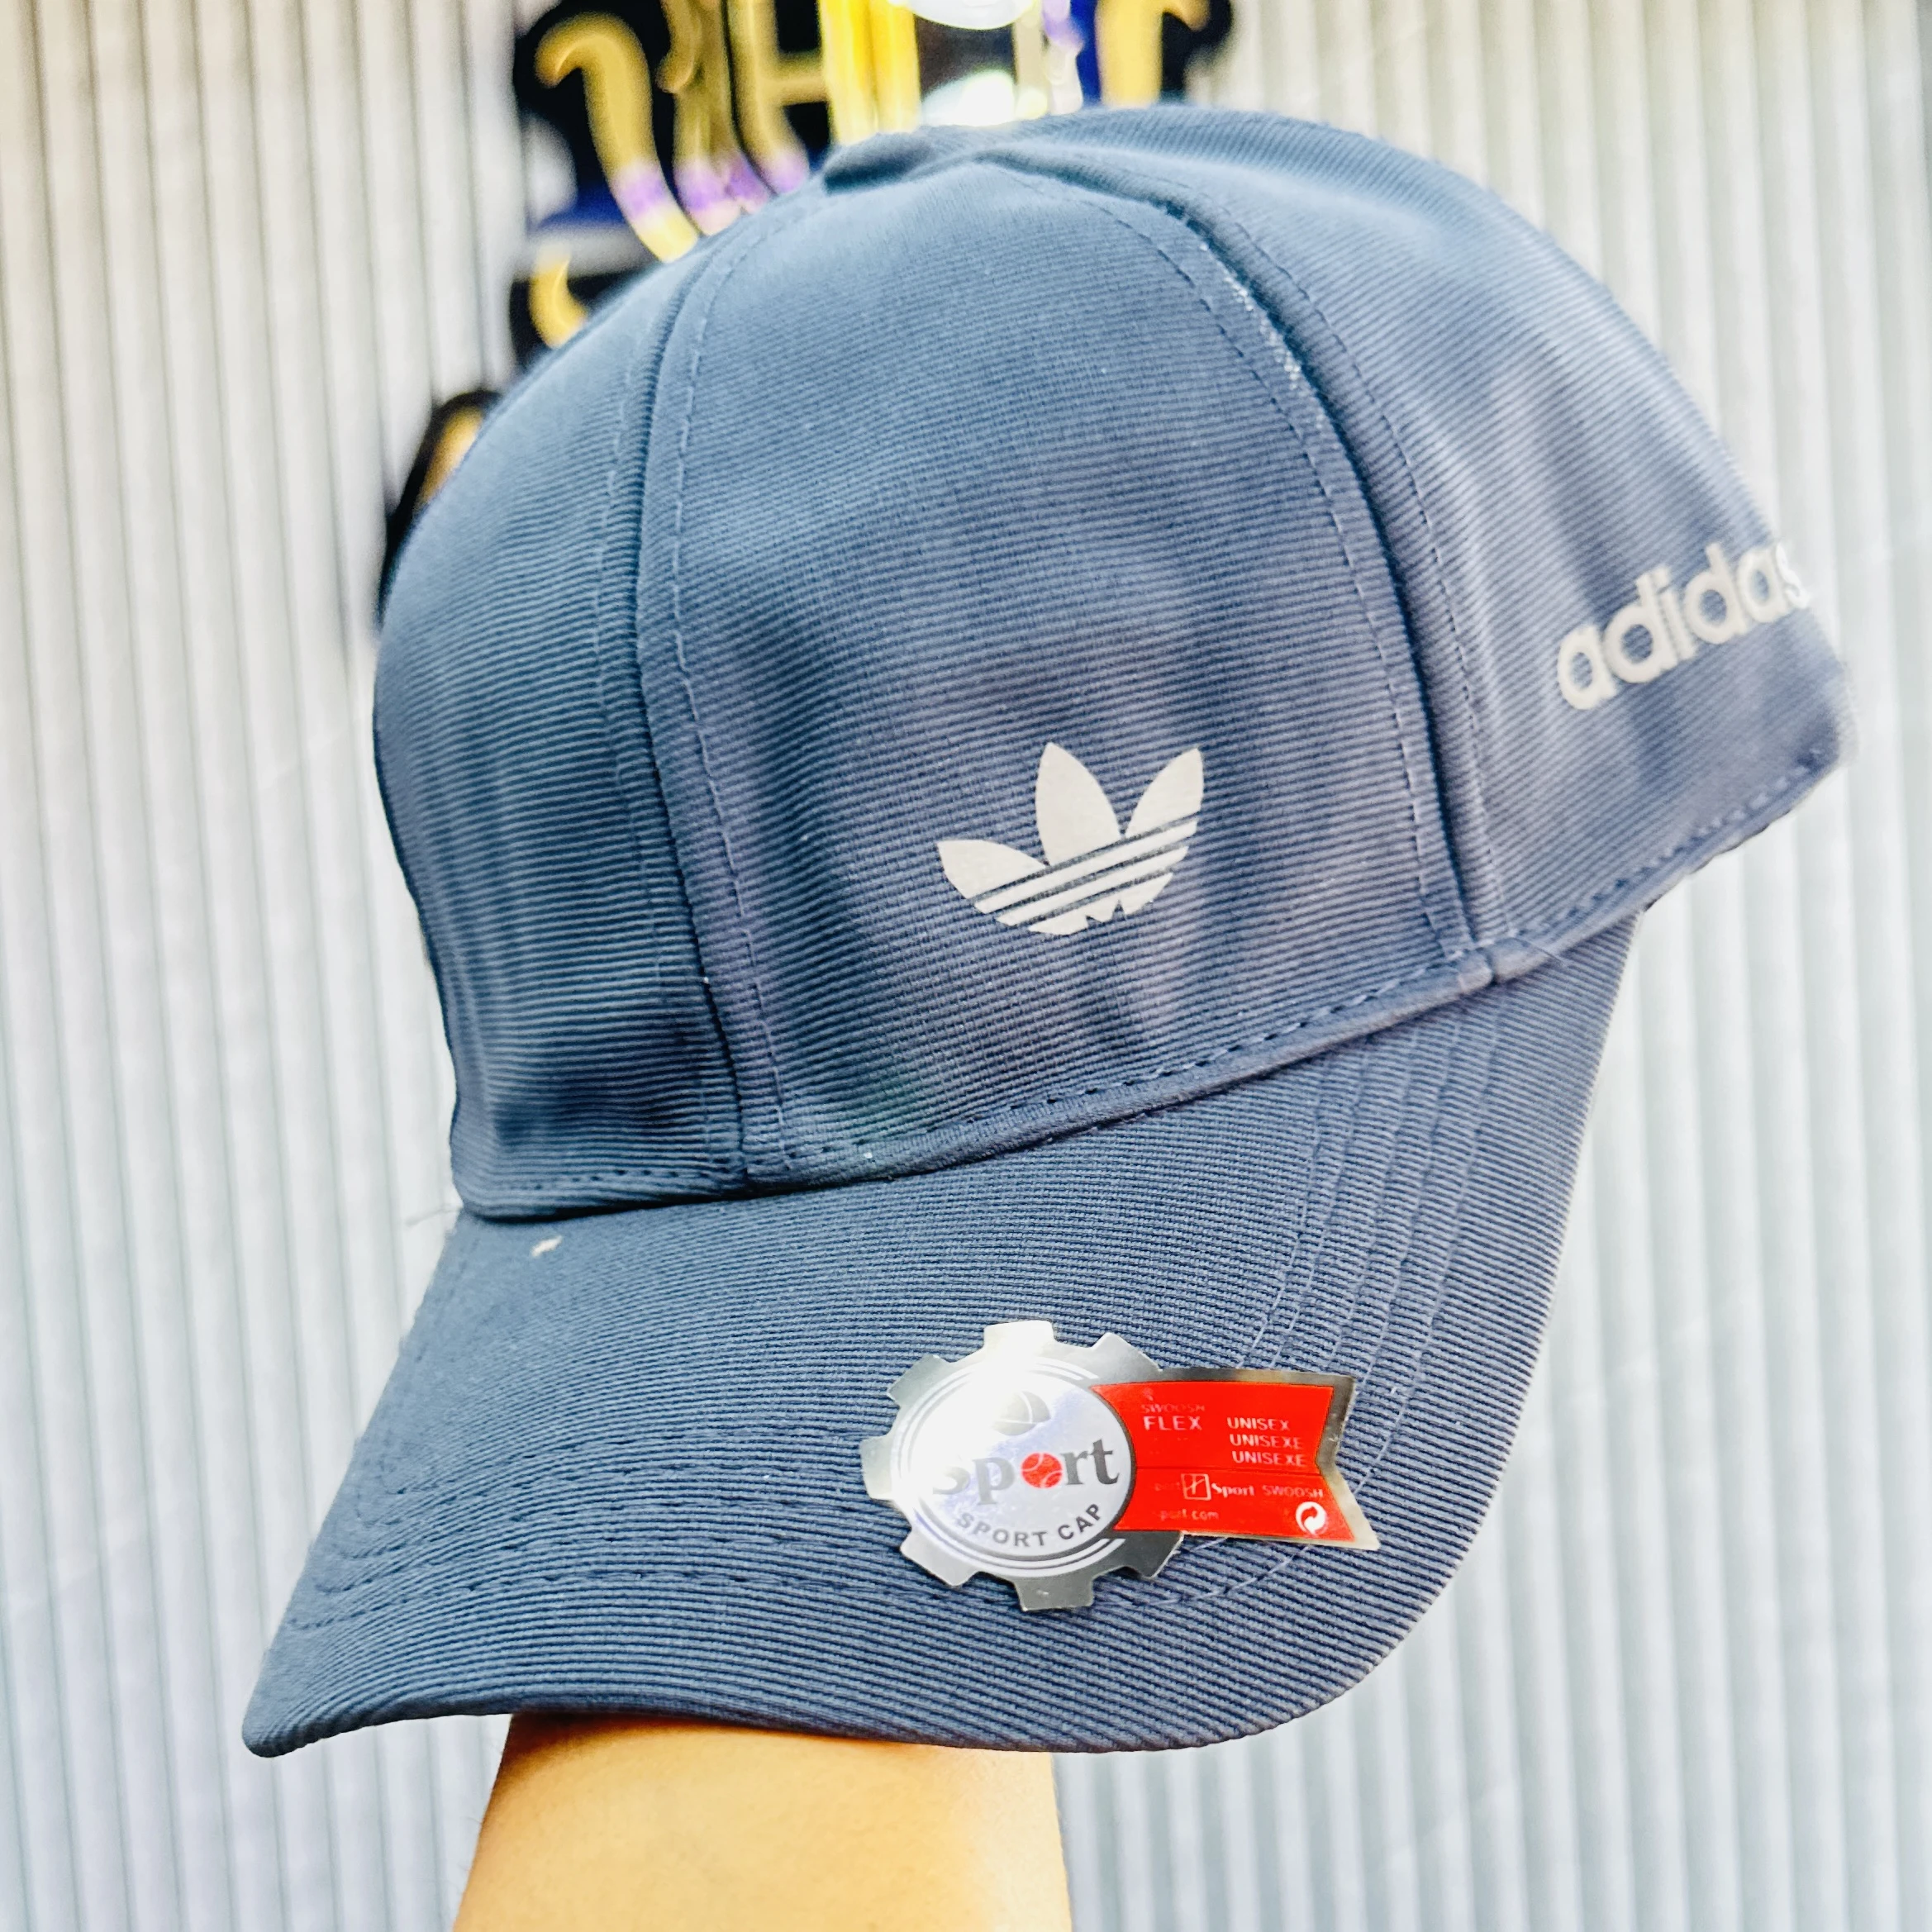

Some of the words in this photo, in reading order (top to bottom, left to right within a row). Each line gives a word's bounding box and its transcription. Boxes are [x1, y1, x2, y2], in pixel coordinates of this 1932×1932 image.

[1557, 542, 1811, 710] adidas
[1143, 1415, 1202, 1430] FLEX
[1227, 1416, 1290, 1431] UNISEX
[1230, 1434, 1303, 1449] UNISEXE
[1231, 1450, 1306, 1467] UNISEXE
[1211, 1482, 1254, 1497] Sport
[1262, 1485, 1323, 1498] SWOOSH
[955, 1511, 1050, 1549] SPORT
[1055, 1502, 1103, 1541] CAP
